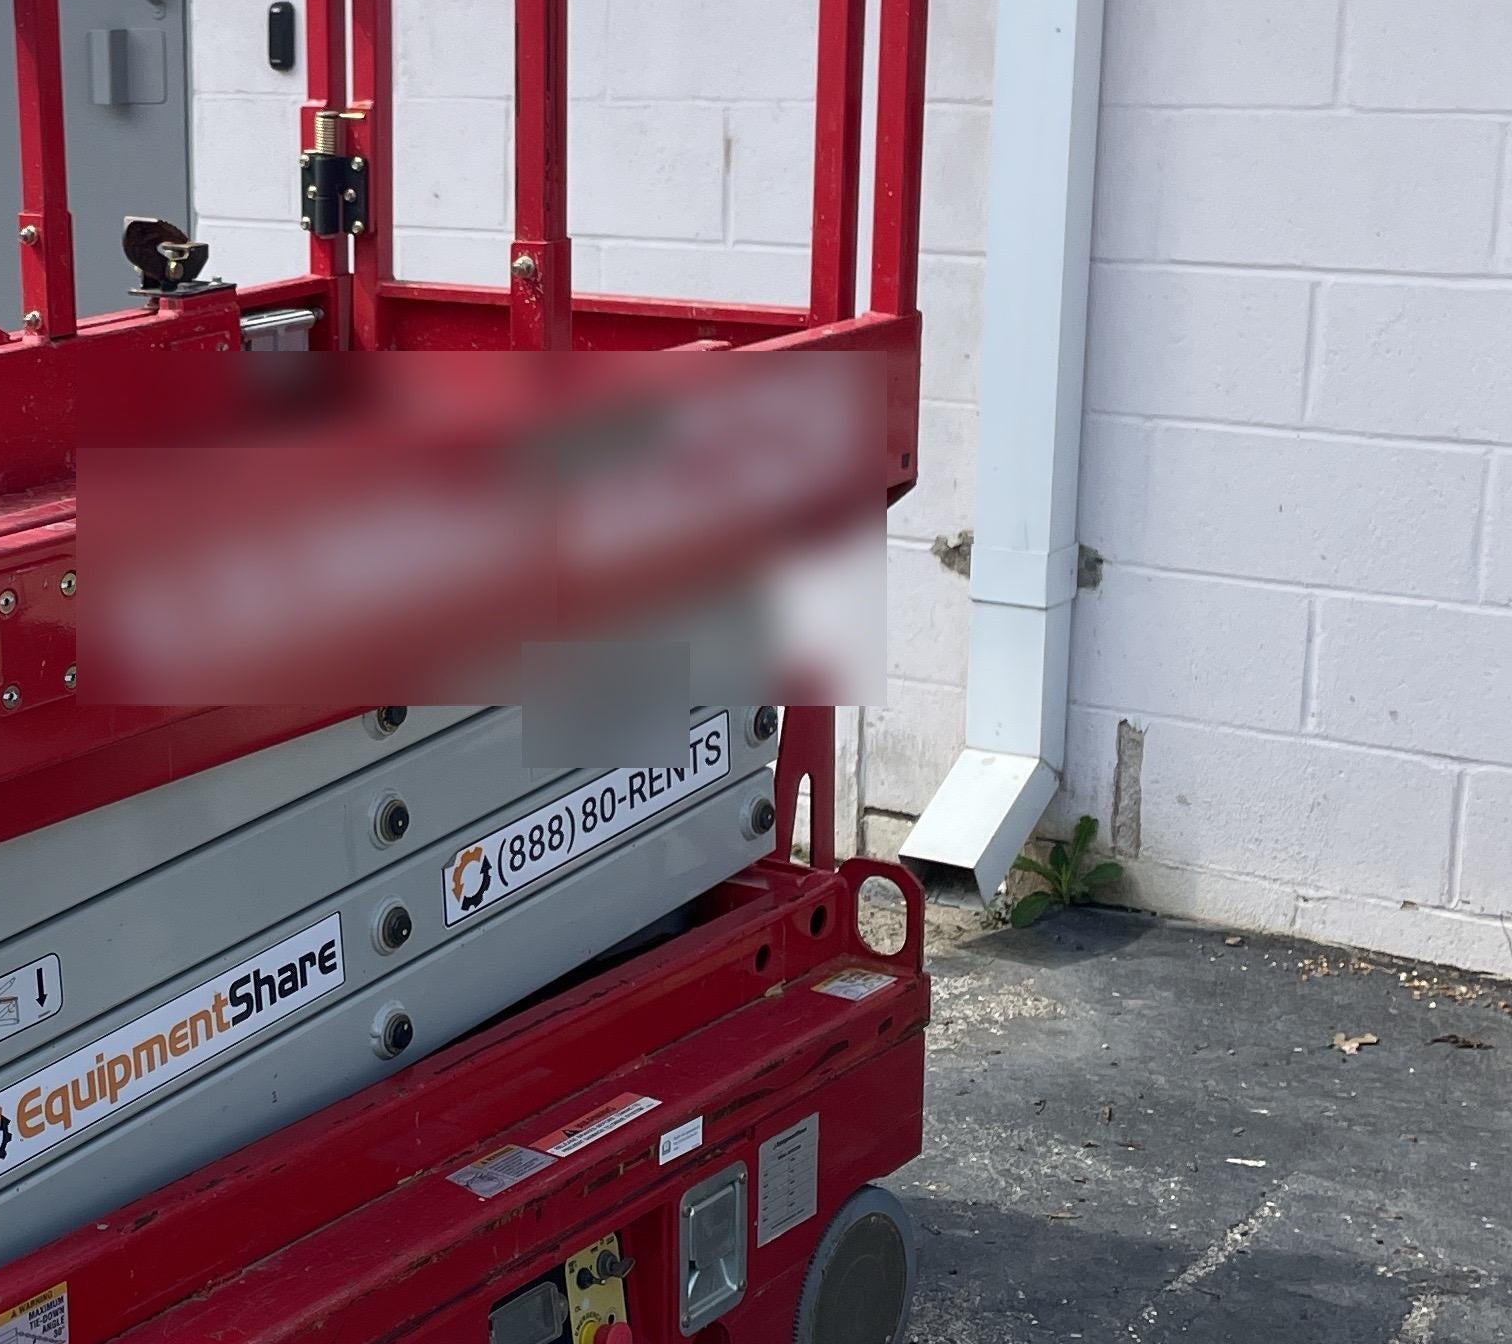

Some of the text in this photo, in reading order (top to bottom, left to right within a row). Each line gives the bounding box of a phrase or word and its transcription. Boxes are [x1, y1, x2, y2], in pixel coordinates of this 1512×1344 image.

[497, 806, 576, 887] (888)
[16, 938, 338, 1140] EquipmentShare
[18, 1290, 54, 1315] WARNING
[28, 1296, 65, 1321] MAXIMUM
[29, 1306, 65, 1330] TIE-DOWN
[42, 1316, 65, 1335] ANGLE
